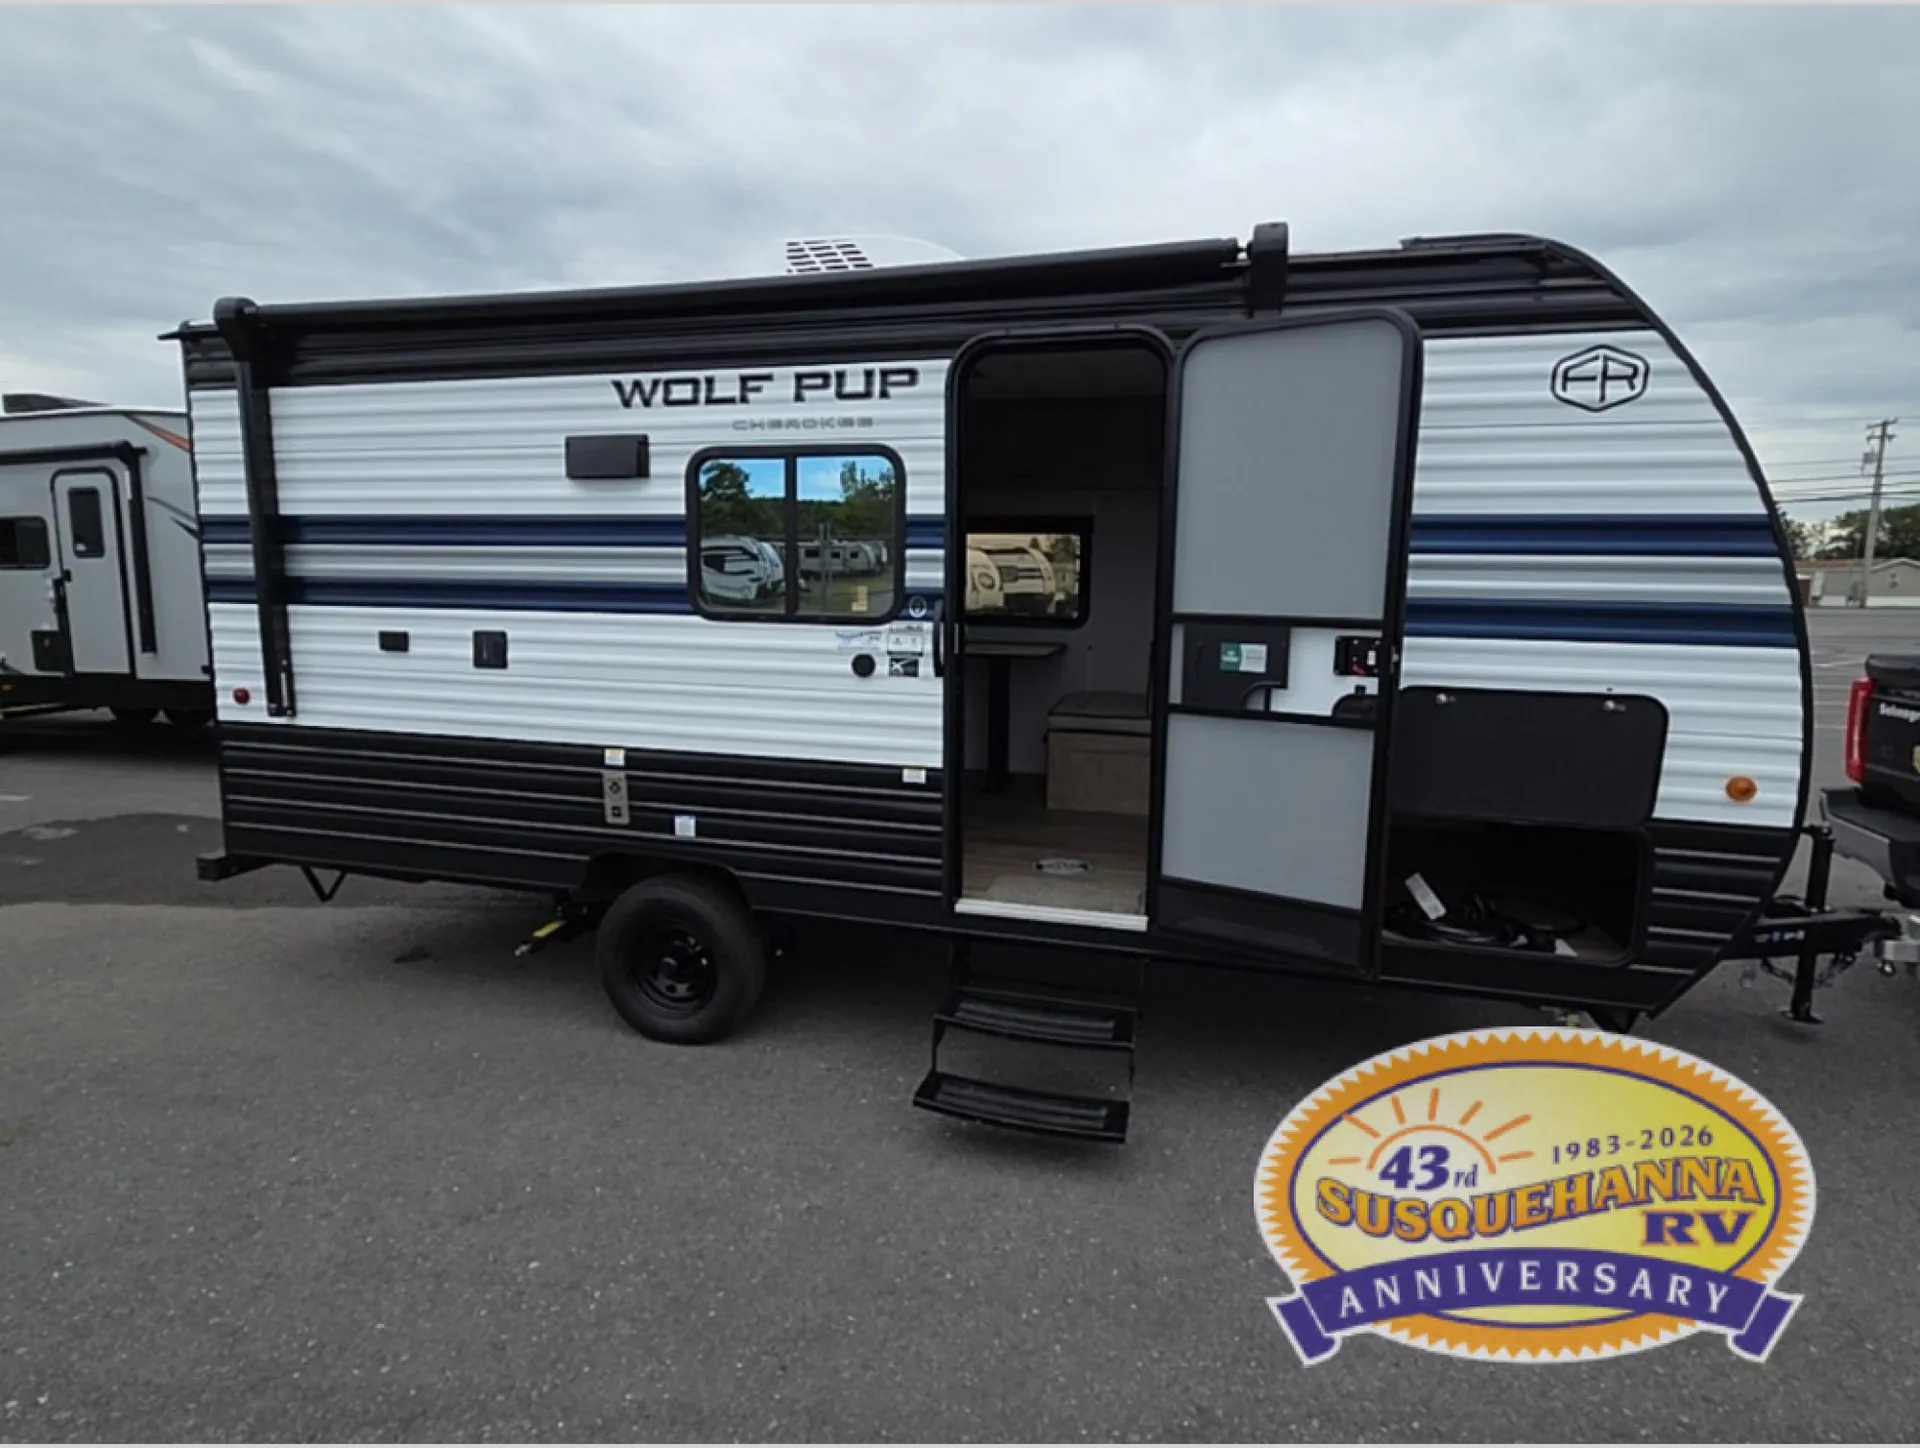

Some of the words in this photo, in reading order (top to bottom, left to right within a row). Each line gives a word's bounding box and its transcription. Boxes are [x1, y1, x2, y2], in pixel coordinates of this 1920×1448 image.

[611, 373, 774, 409] WOLF
[794, 368, 920, 402] PUP
[732, 416, 874, 431] CHEROKEE
